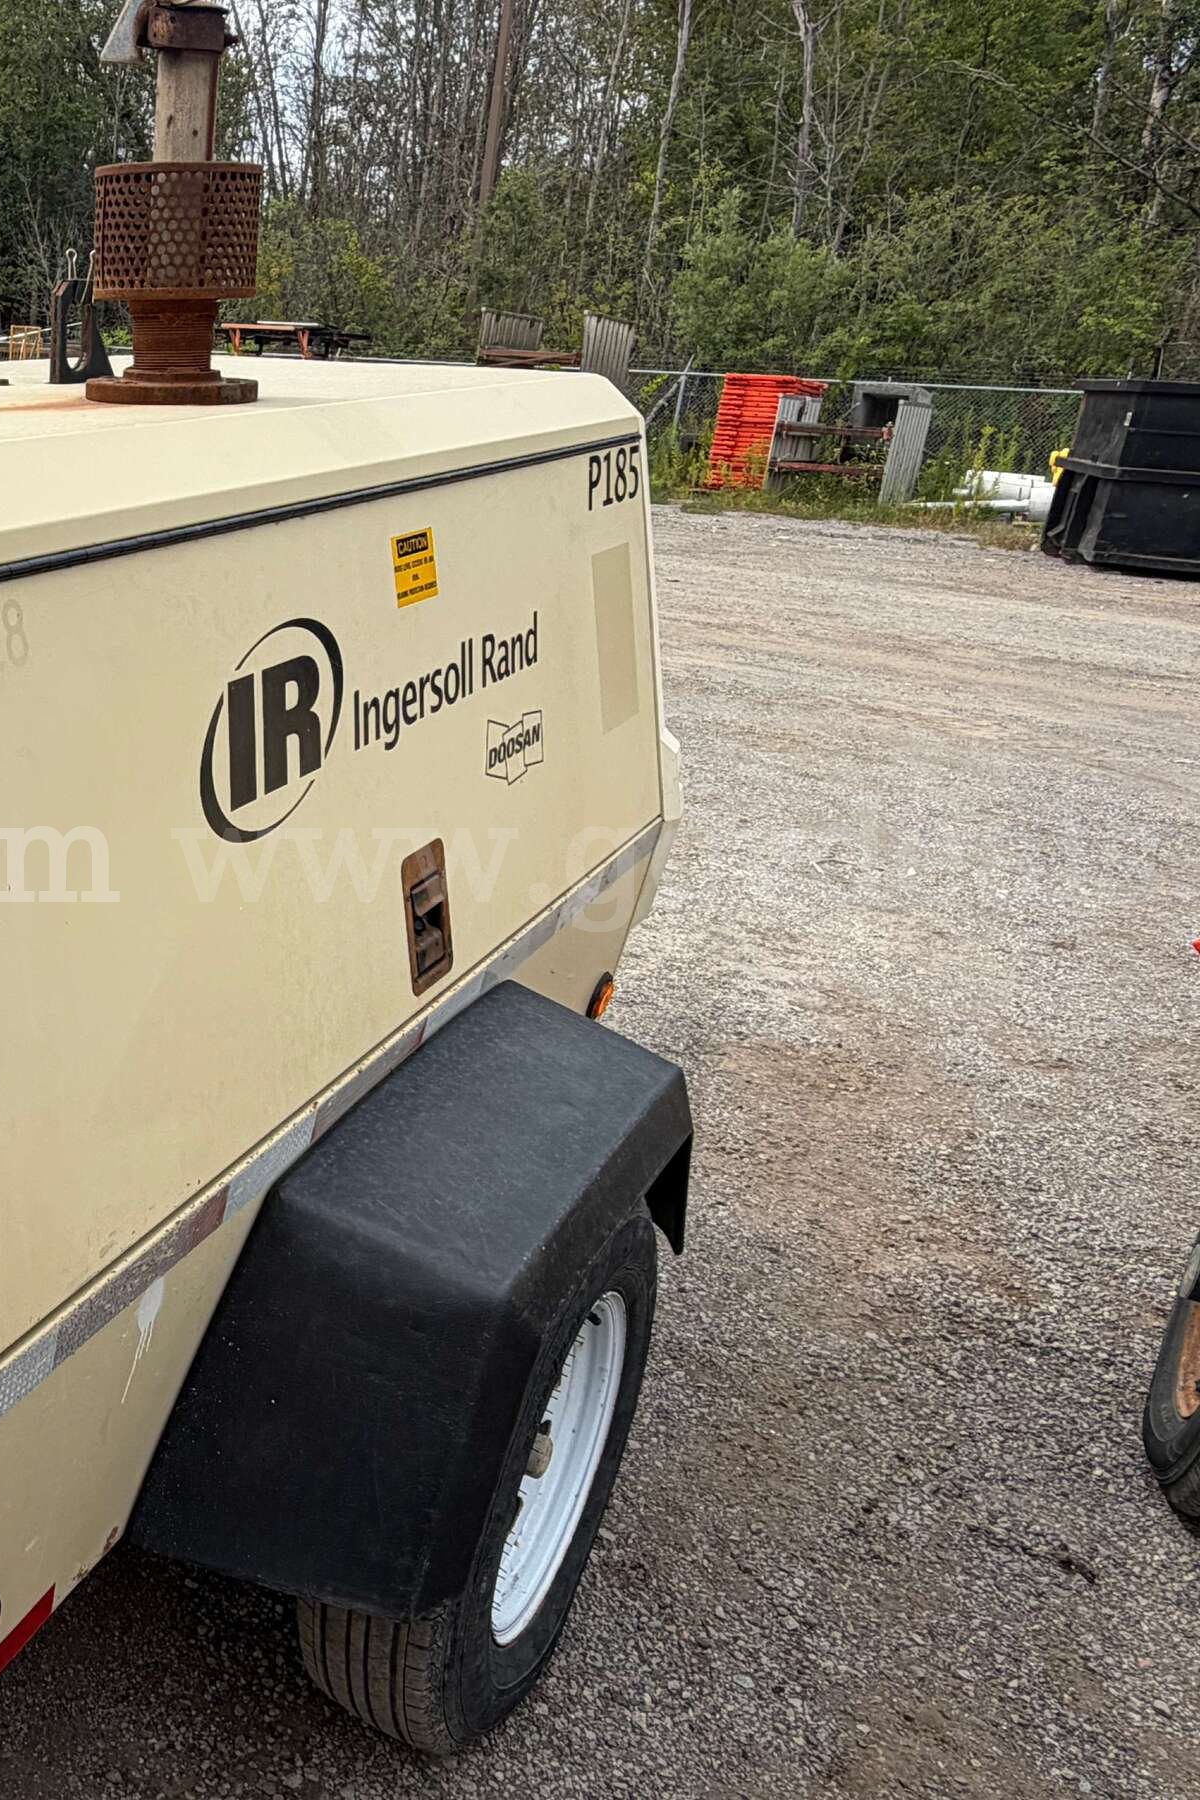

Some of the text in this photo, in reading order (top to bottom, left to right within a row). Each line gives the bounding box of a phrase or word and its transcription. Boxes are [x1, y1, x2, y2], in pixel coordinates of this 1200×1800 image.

[588, 445, 639, 511] P185
[398, 535, 427, 555] CAUTION
[353, 610, 538, 751] Ingersoll Rand
[227, 654, 322, 813] IR
[488, 722, 540, 770] DOOSAN
